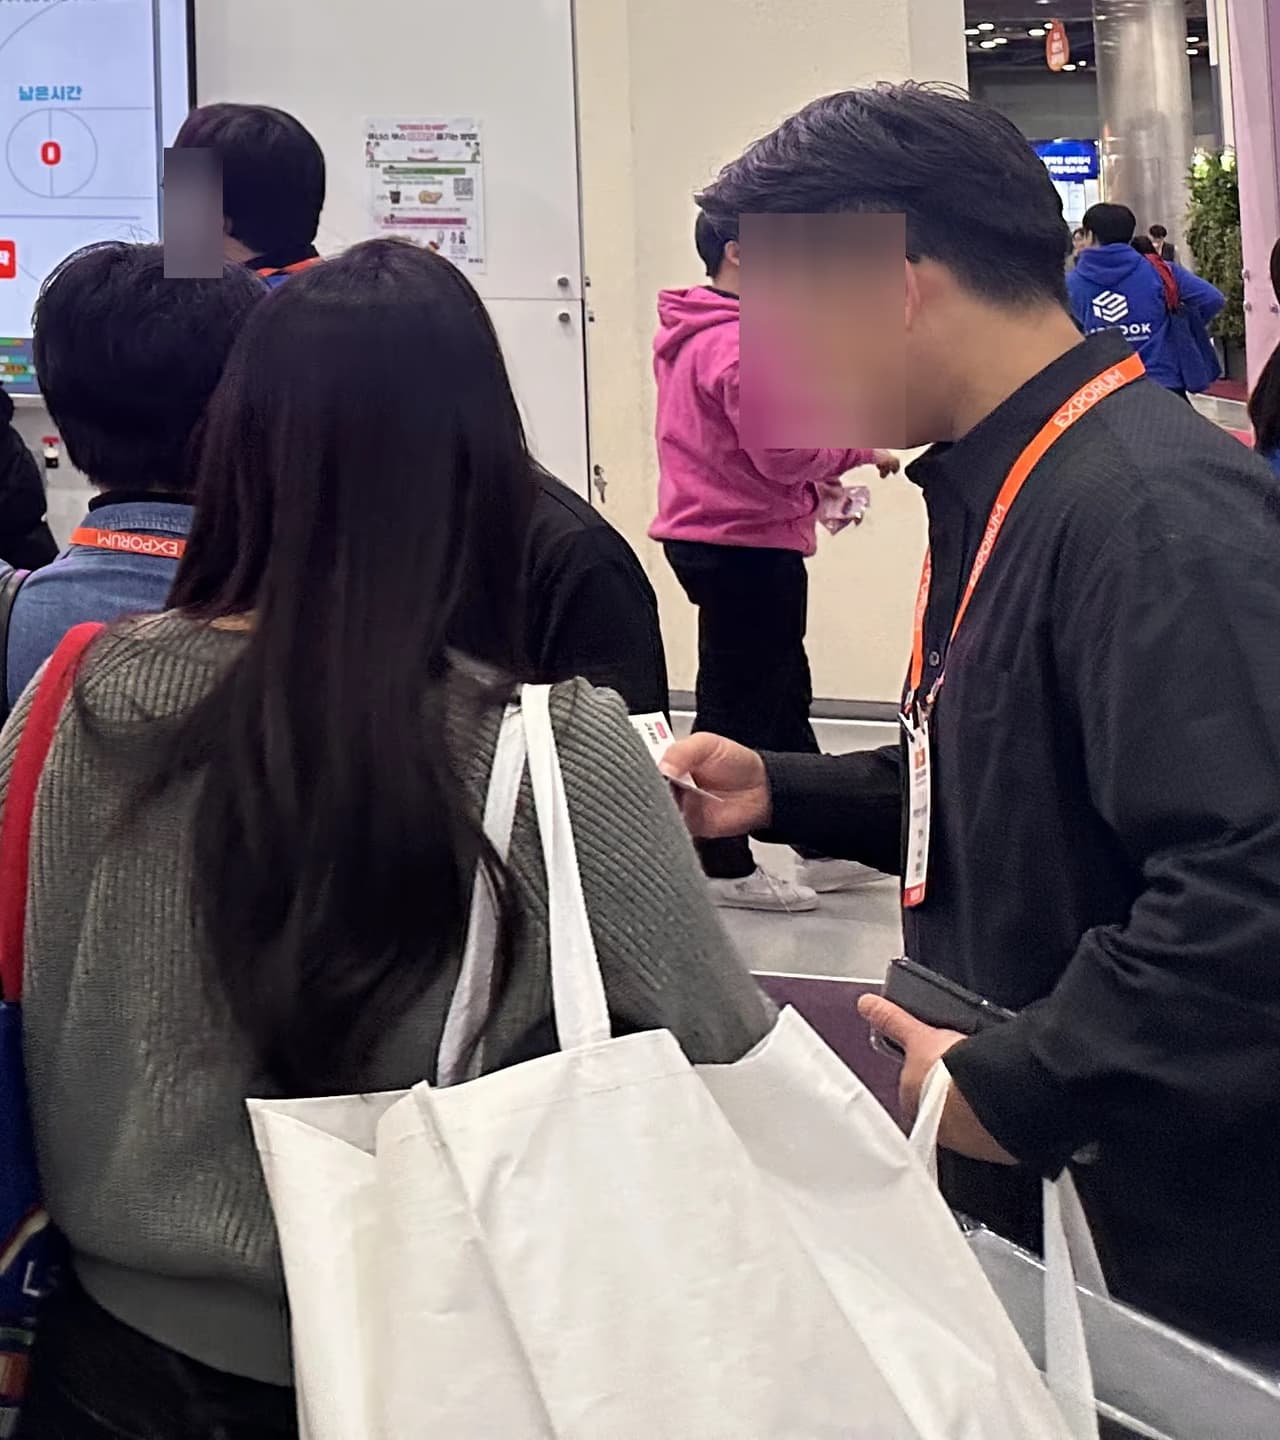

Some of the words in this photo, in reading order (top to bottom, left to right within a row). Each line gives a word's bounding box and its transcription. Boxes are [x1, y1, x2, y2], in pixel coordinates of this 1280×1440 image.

[40, 141, 62, 166] 0
[1053, 369, 1125, 428] EXPORUM
[97, 532, 179, 555] EXPORUM
